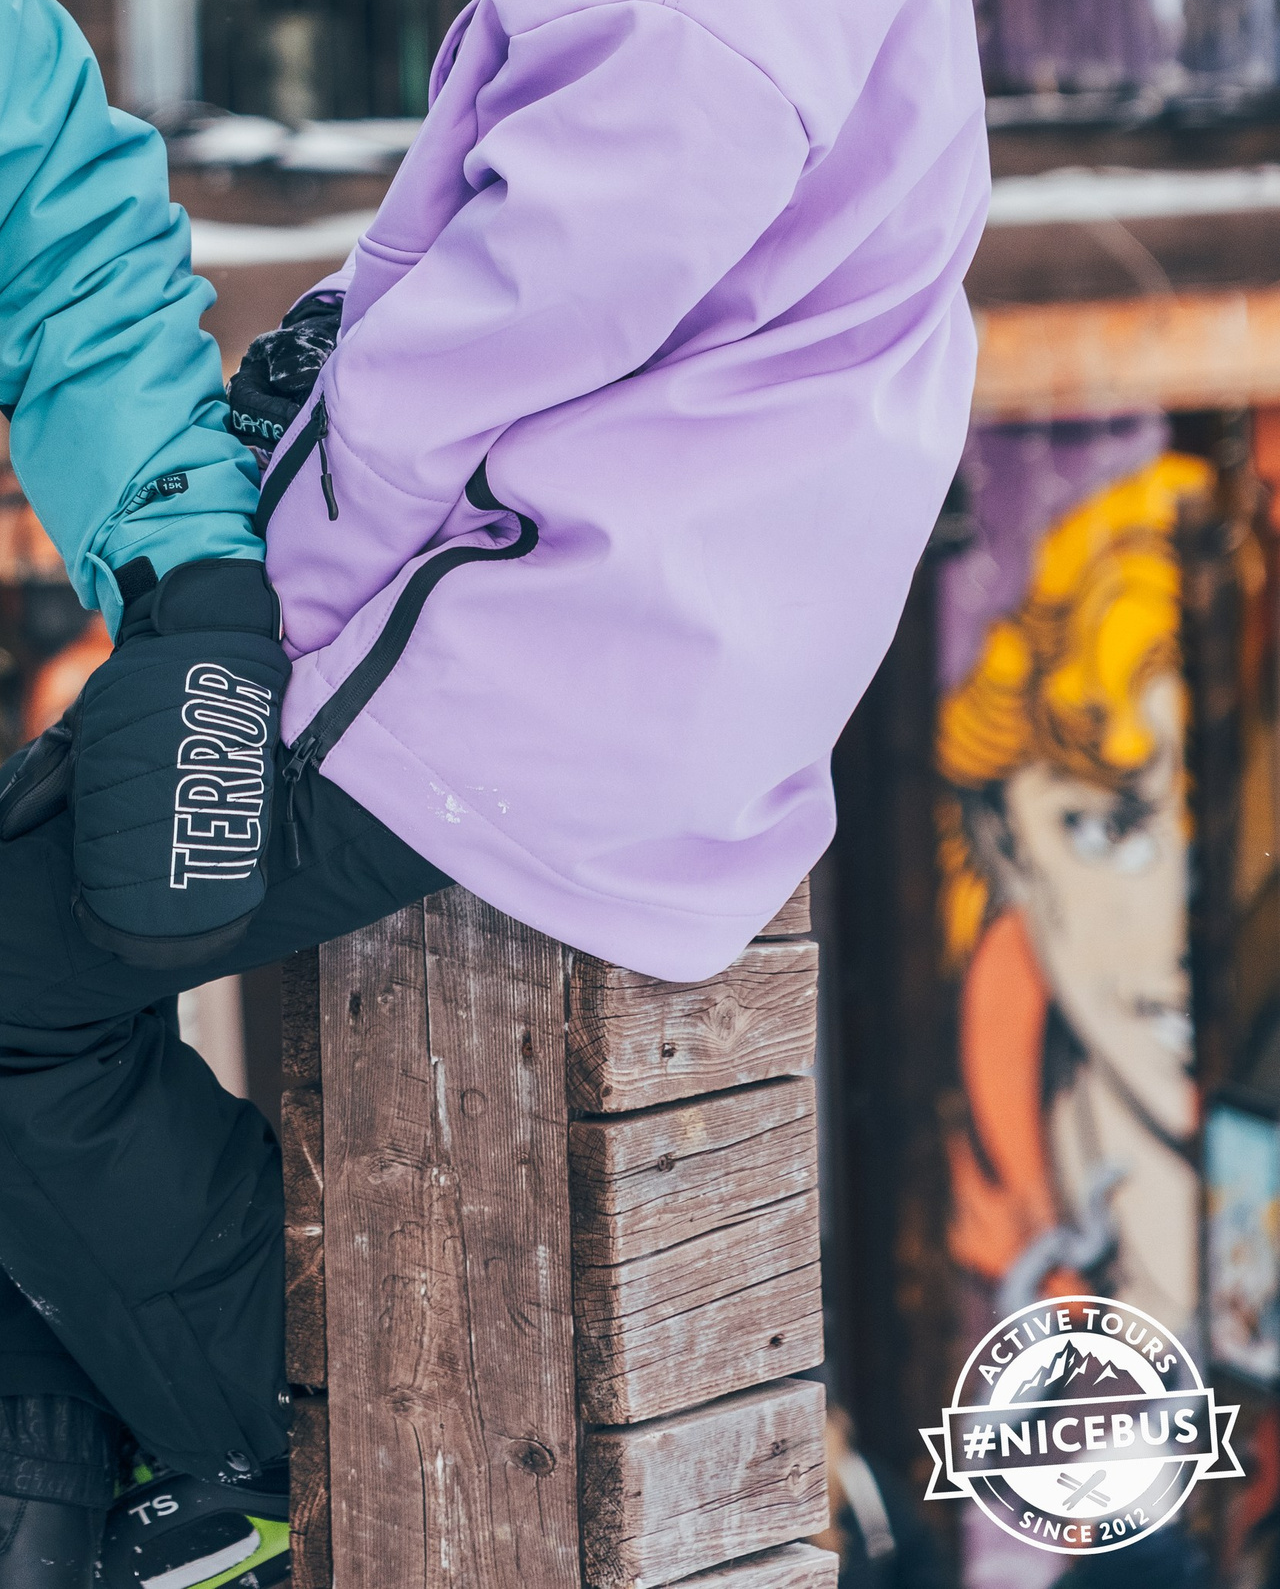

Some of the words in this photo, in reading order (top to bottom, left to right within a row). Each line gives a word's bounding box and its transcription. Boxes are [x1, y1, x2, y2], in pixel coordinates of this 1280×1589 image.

[162, 482, 183, 491] 15K
[170, 662, 272, 890] TERROR
[128, 1494, 179, 1525] TS
